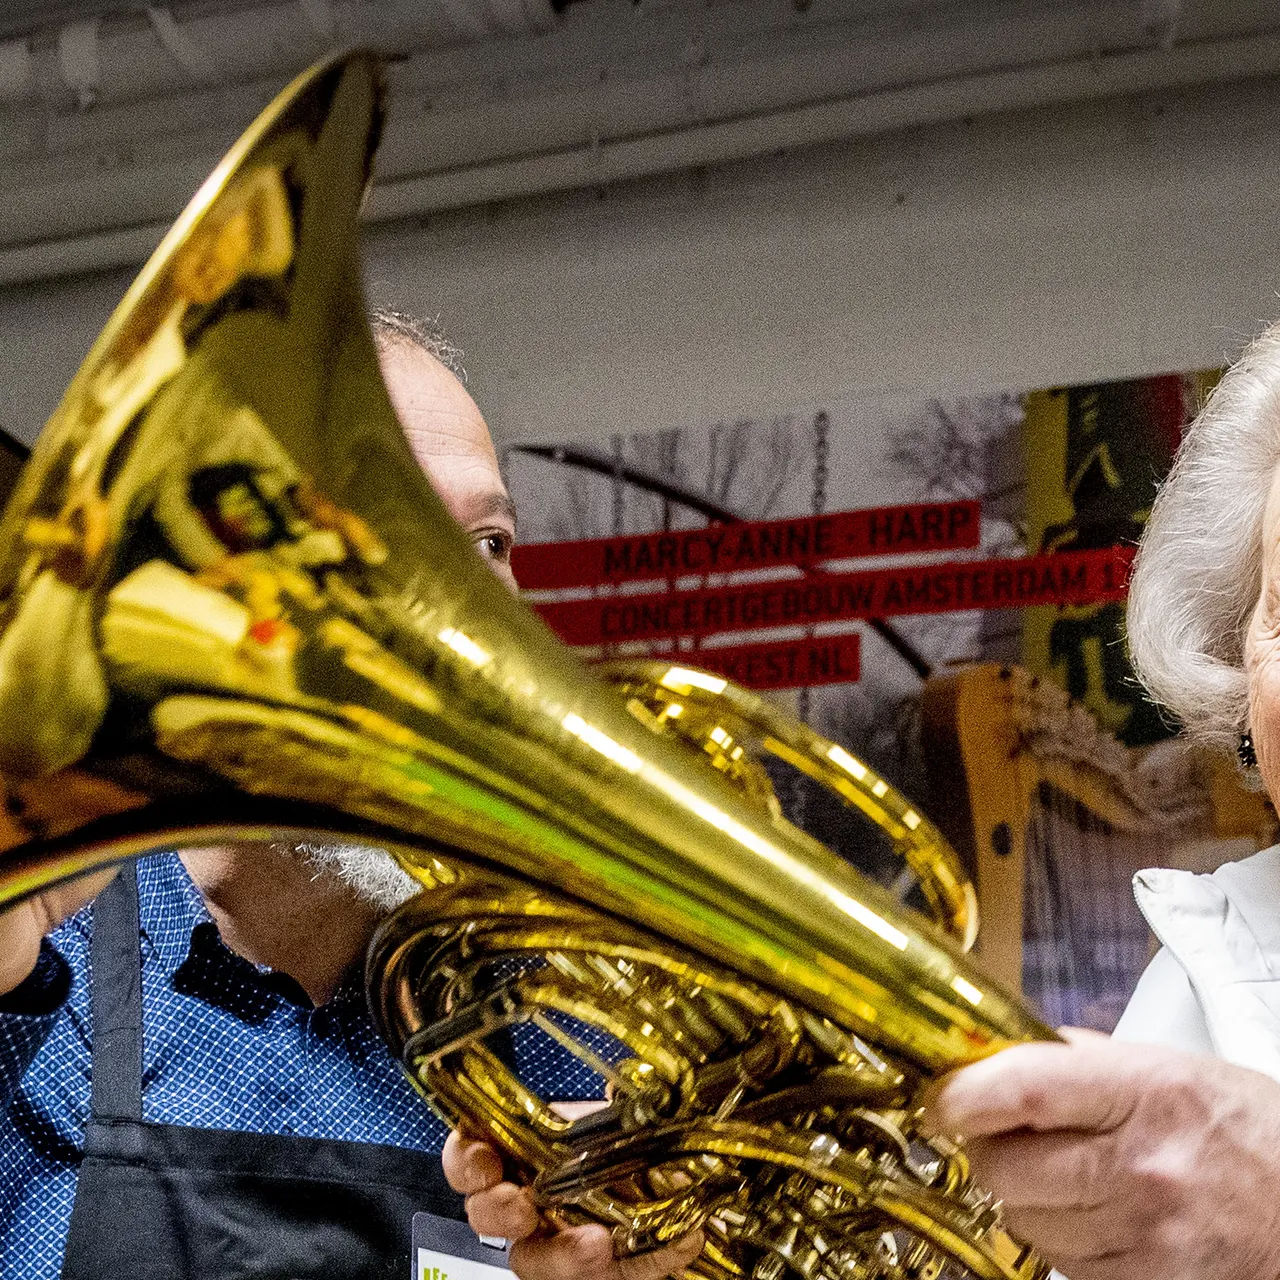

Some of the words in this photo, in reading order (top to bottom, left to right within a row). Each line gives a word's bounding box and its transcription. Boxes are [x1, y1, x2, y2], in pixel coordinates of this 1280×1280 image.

[868, 504, 973, 548] HARP
[600, 579, 874, 638] CONCERTGEBOUW
[880, 562, 1089, 610] AMSTERDAM
